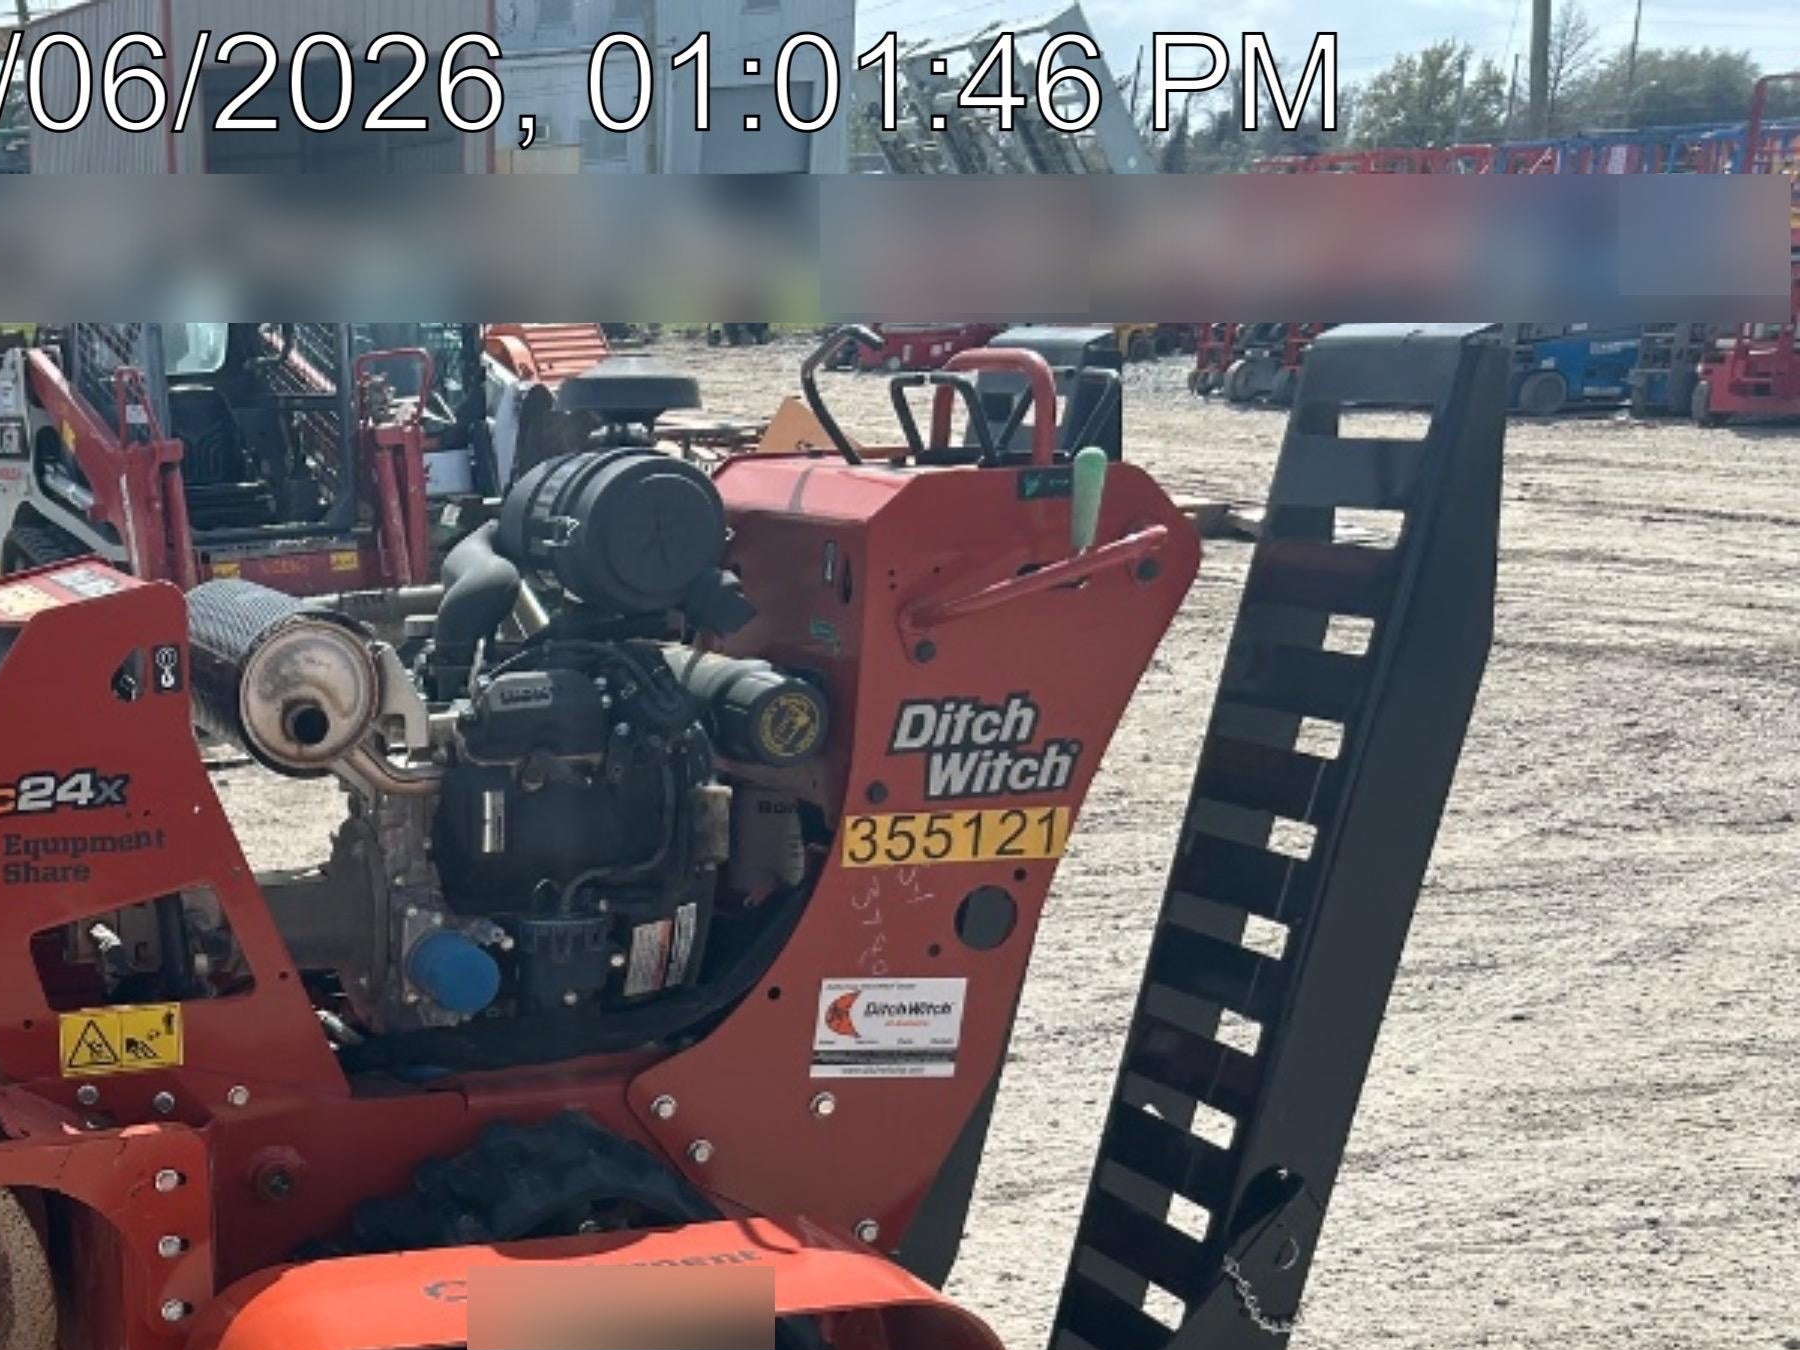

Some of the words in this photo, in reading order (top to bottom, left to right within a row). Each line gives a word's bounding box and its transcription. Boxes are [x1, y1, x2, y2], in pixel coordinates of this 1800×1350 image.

[892, 697, 1038, 750] Ditch
[928, 743, 1076, 798] Witch
[3, 830, 167, 860] Equipment
[847, 806, 1060, 866] 355121
[2, 862, 92, 885] Share
